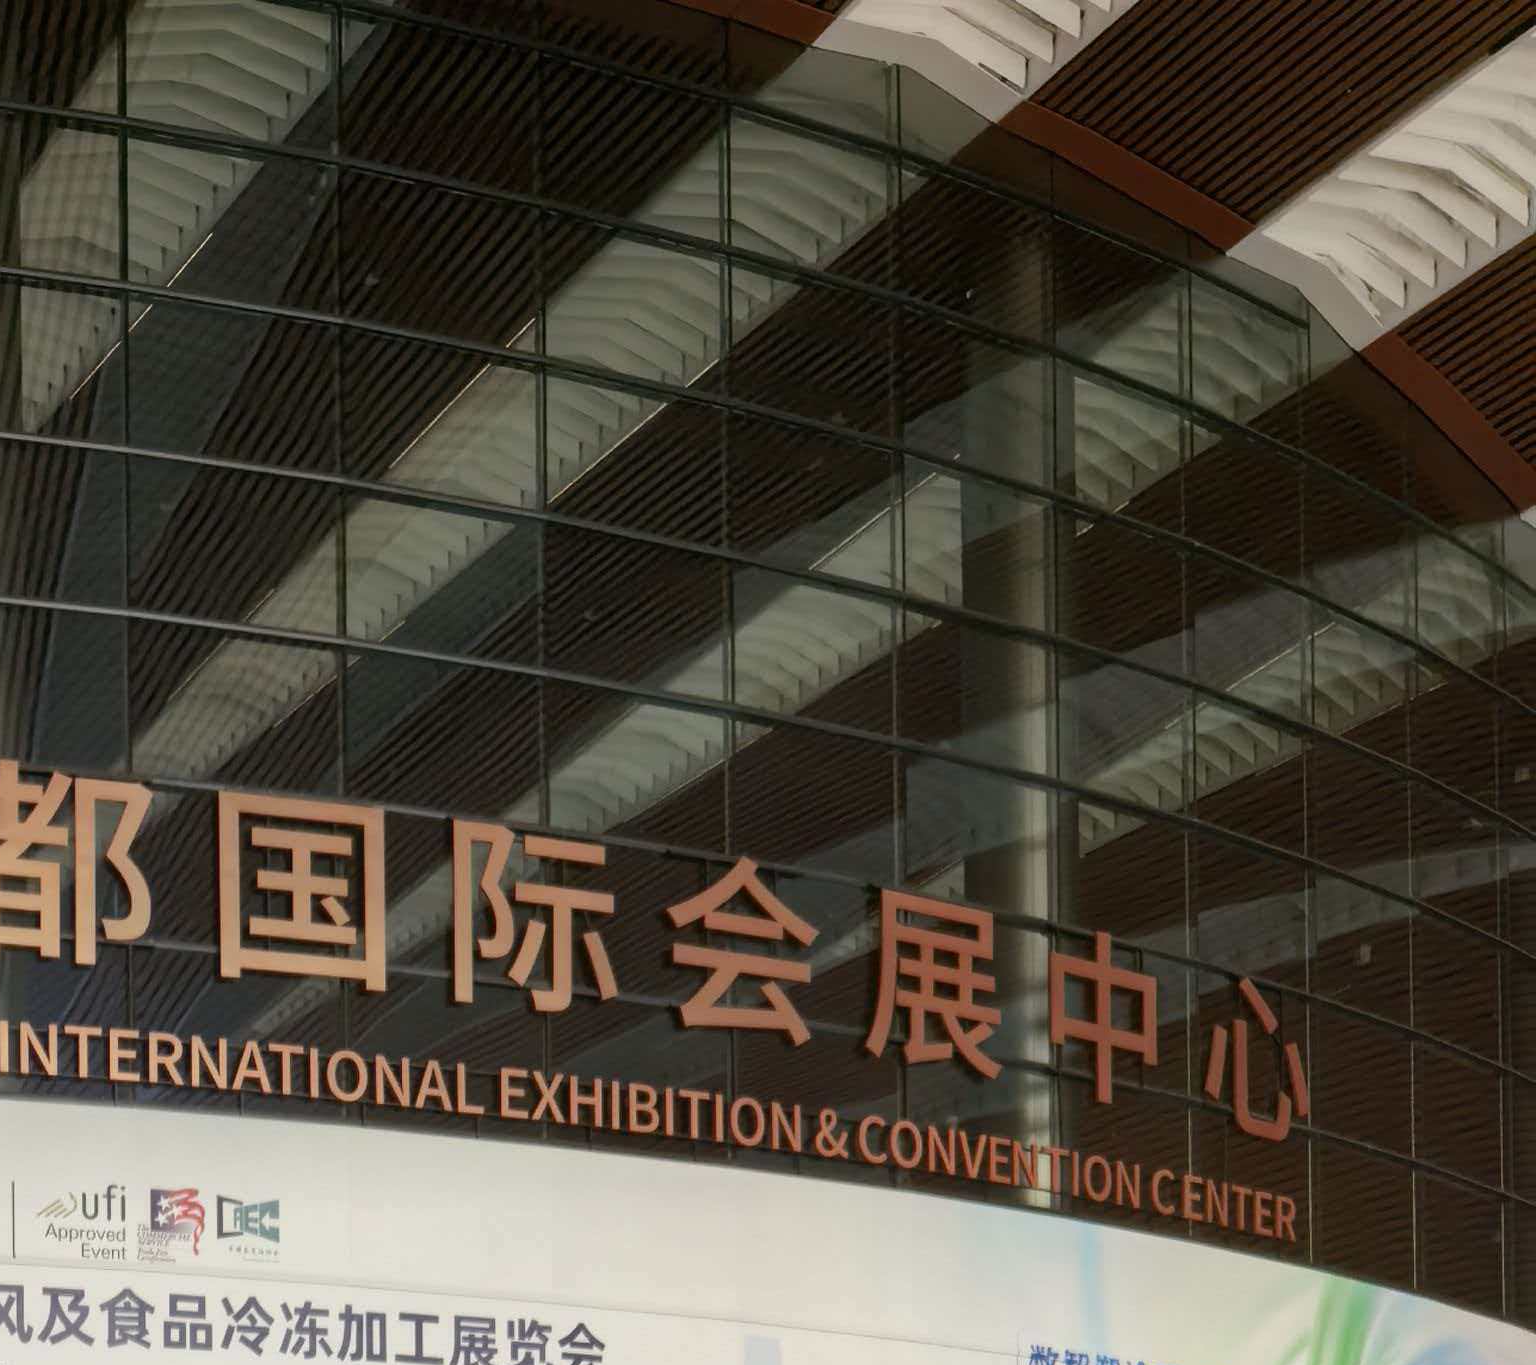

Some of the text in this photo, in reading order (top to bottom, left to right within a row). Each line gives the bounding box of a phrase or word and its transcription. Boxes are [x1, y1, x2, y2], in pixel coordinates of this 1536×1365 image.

[498, 1063, 804, 1152] EXHIBITION
[814, 1103, 850, 1158] &
[858, 1114, 1142, 1211] CONVENTION
[1149, 1165, 1299, 1243] CENTER
[82, 1185, 126, 1222] ufi
[45, 1223, 126, 1243] Approved
[81, 1243, 126, 1260] Event
